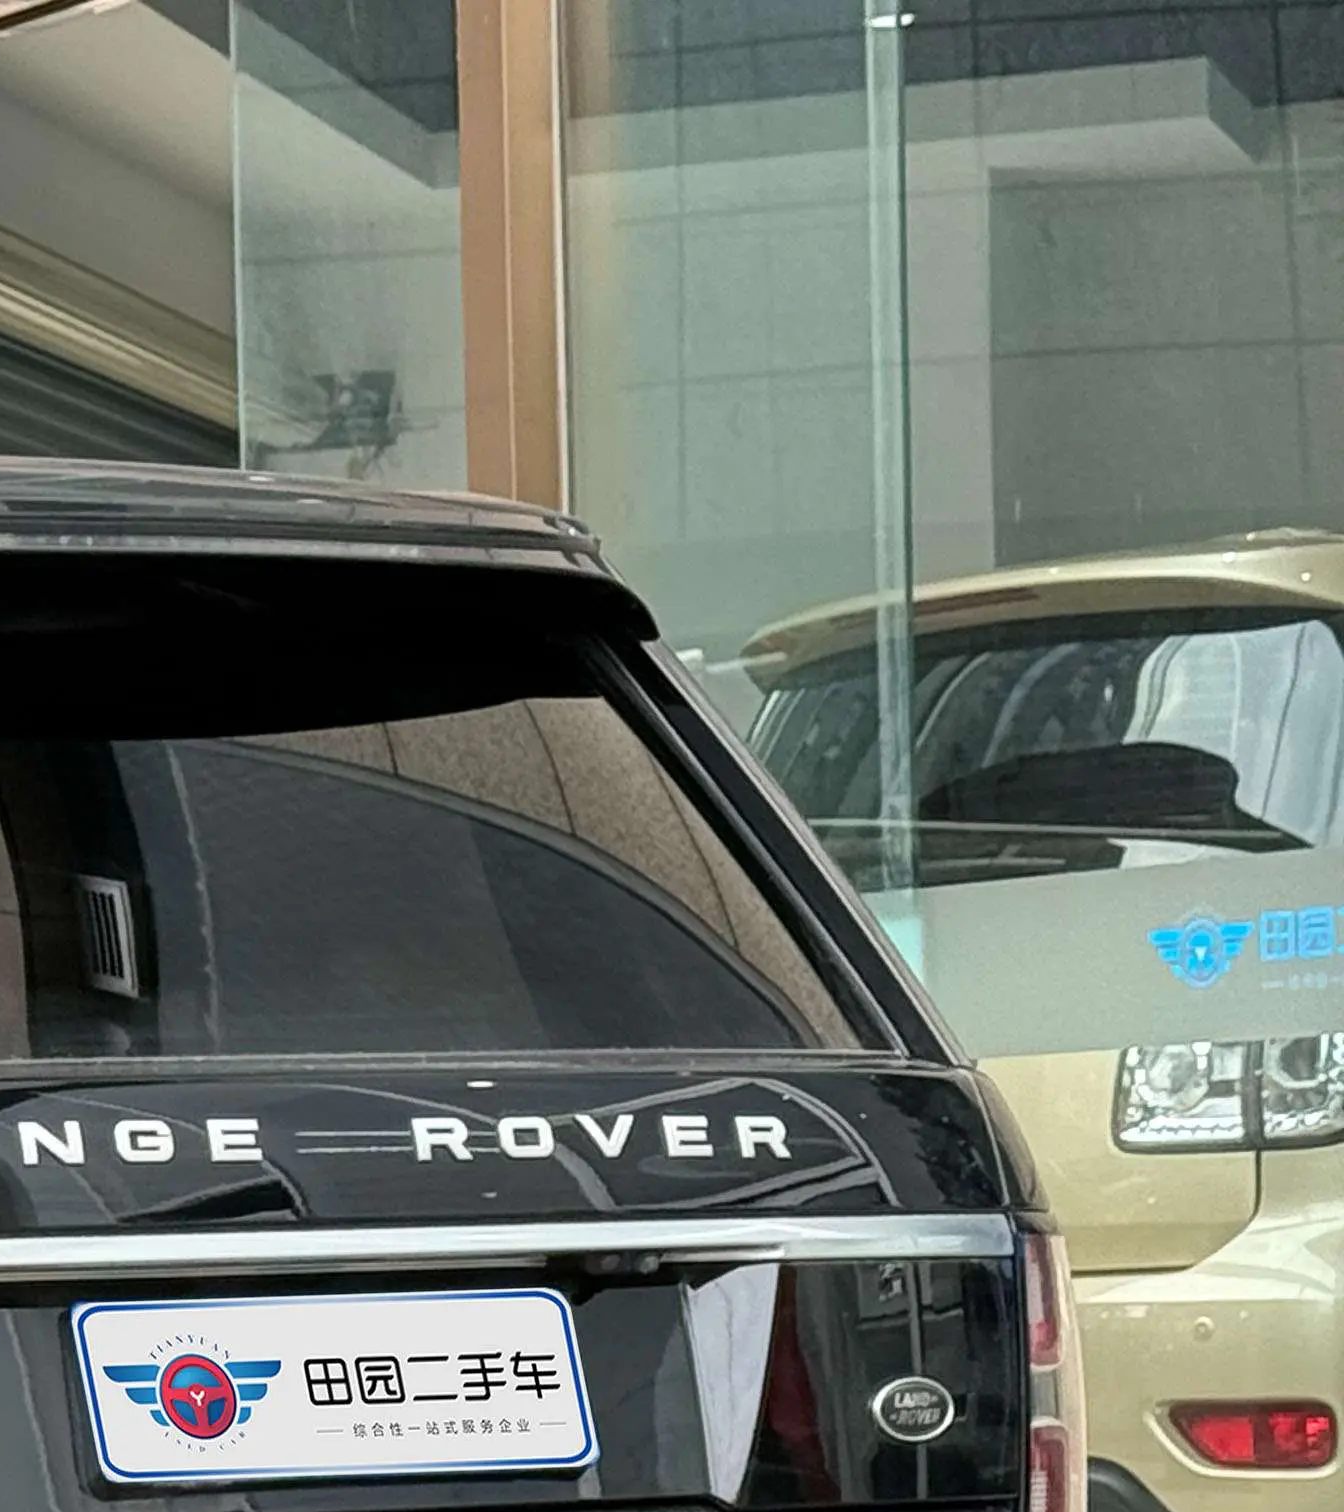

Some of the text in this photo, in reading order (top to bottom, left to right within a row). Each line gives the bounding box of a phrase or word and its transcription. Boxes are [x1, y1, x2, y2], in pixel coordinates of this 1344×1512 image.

[1260, 906, 1344, 961] 田园
[413, 1113, 792, 1162] ROVER
[303, 1351, 561, 1406] 田园二手车
[352, 1417, 531, 1439] 综合性一站式服务企业
